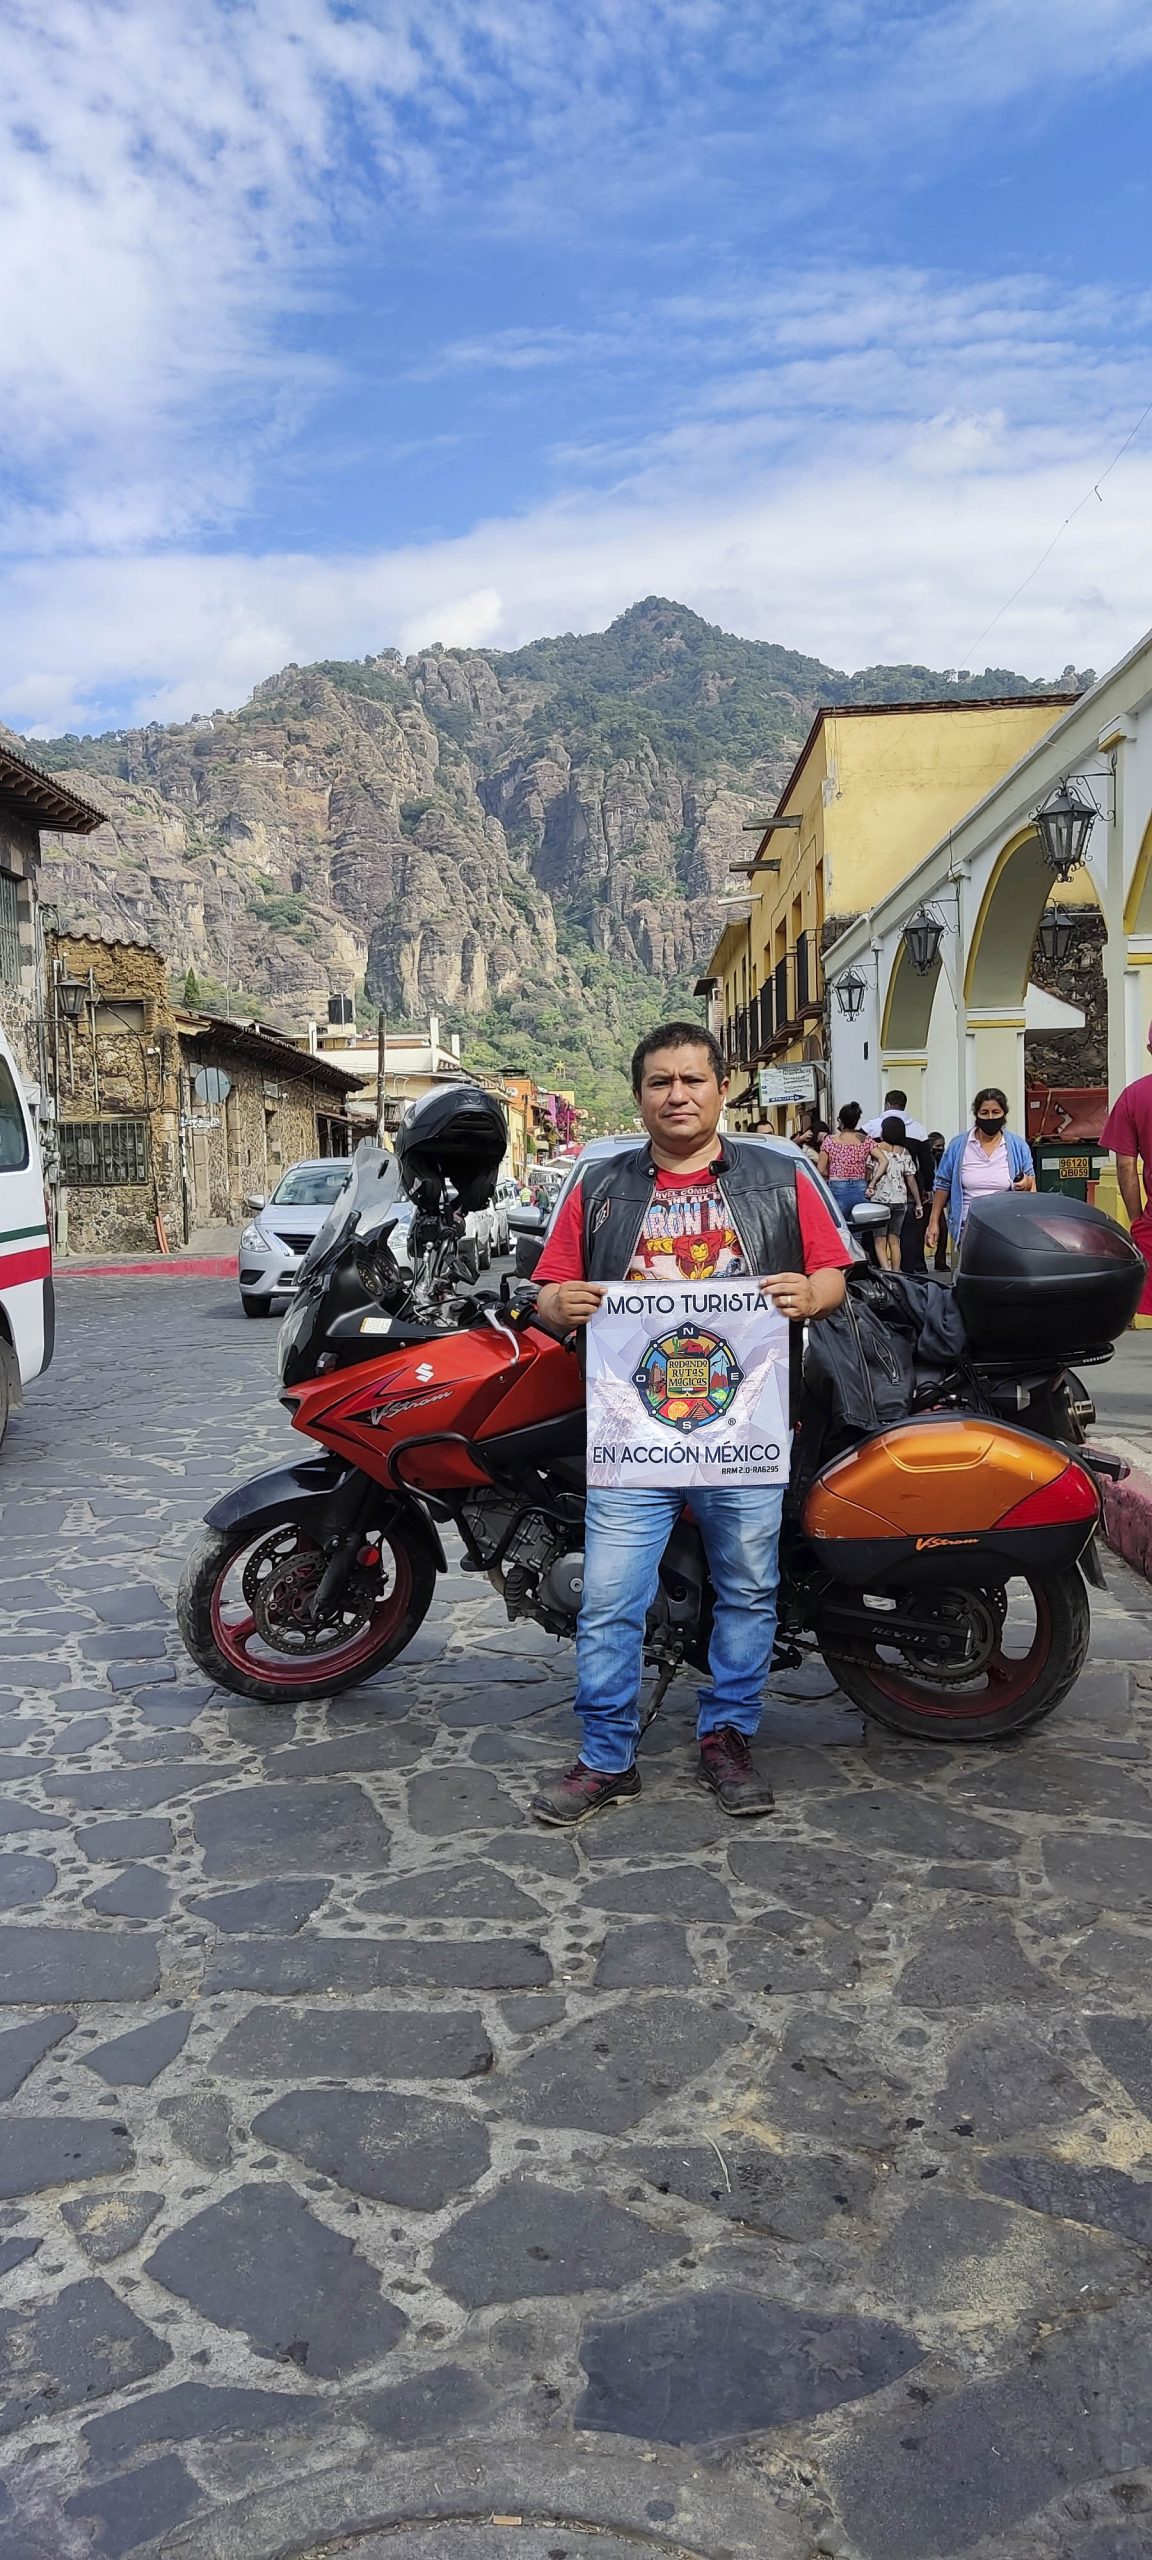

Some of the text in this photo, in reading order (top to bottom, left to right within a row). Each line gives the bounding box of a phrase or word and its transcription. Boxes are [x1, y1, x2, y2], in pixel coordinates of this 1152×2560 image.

[655, 1190, 679, 1199] RVEL
[606, 1292, 769, 1315] MOTO TURISTA
[593, 1440, 781, 1464] EN ACCIÓN MÉXICO
[721, 1467, 738, 1475] RRM
